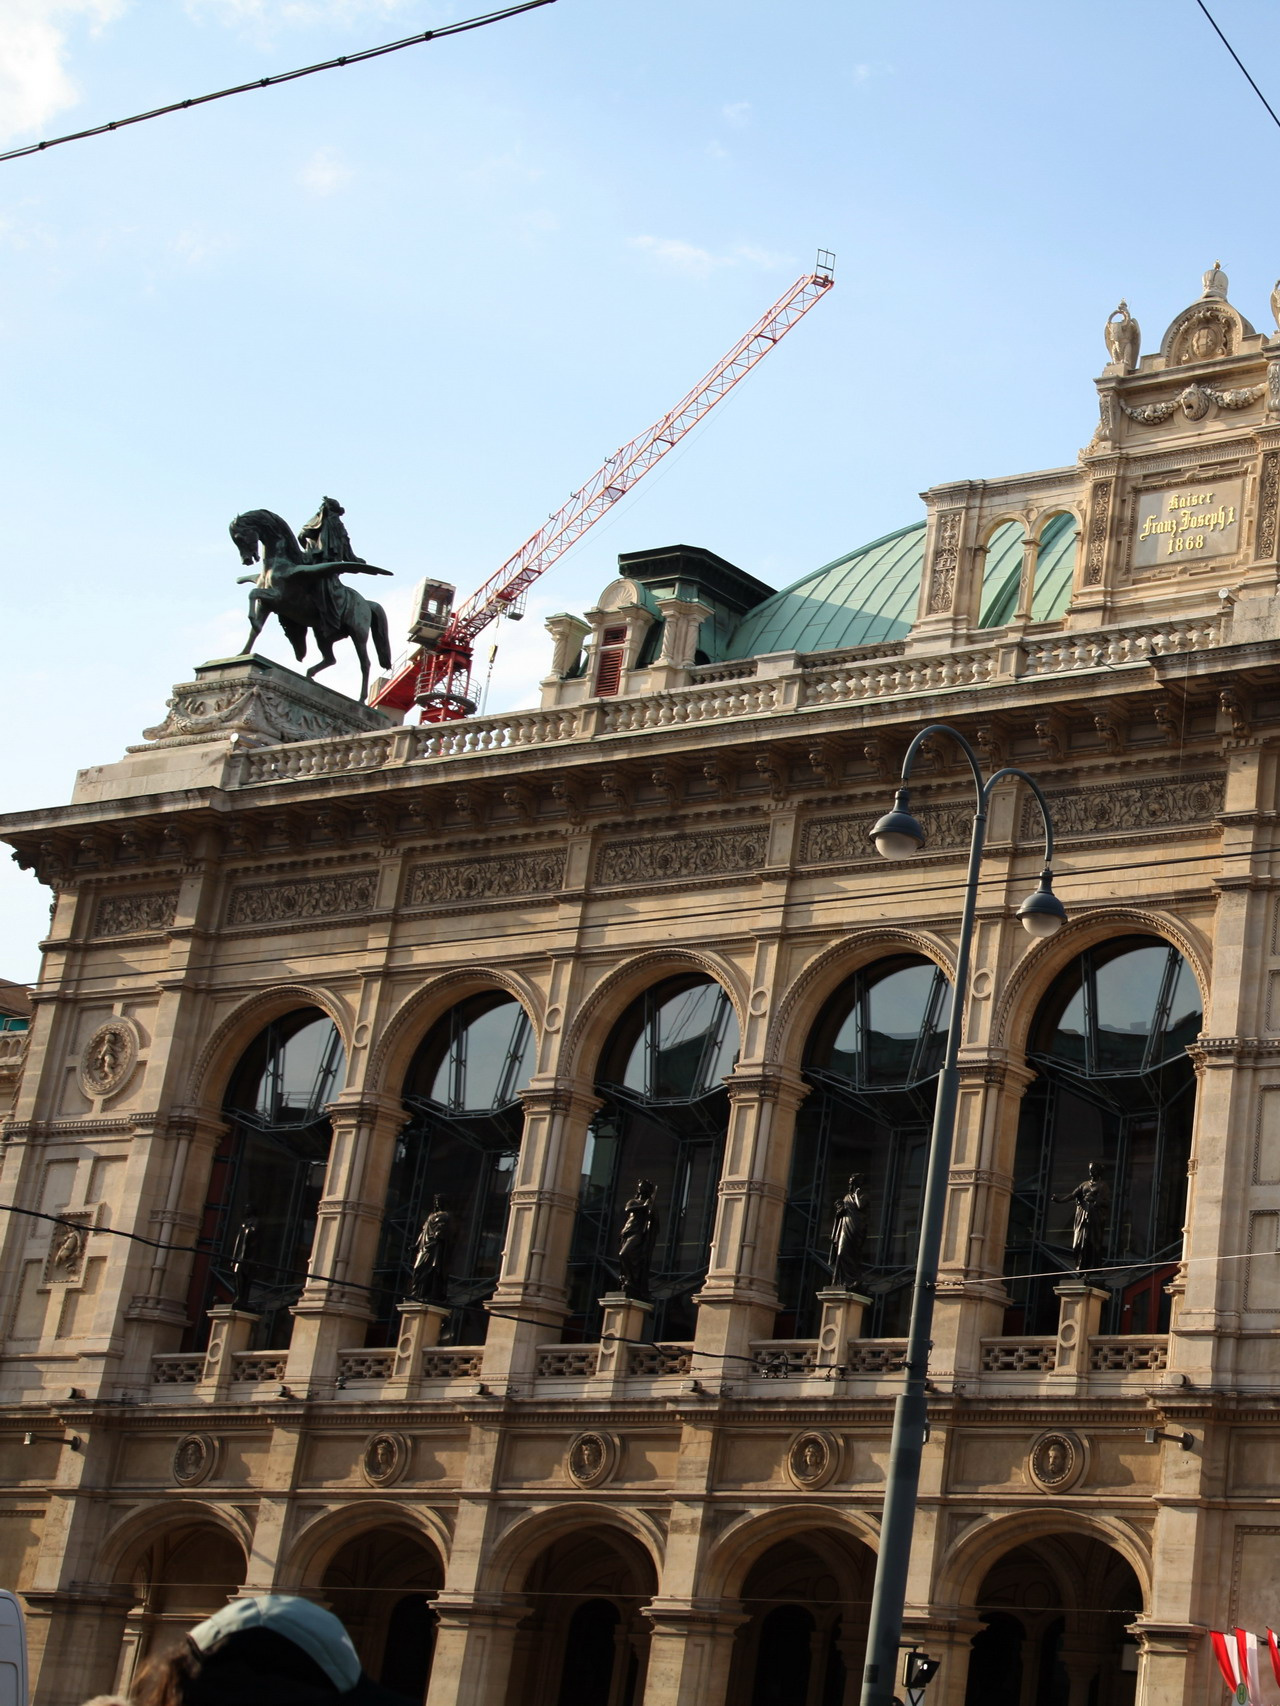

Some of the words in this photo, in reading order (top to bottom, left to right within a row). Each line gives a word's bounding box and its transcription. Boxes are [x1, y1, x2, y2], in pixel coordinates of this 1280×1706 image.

[1168, 493, 1214, 512] Kaiser
[1140, 515, 1177, 540] Franz
[1168, 534, 1204, 555] 1868
